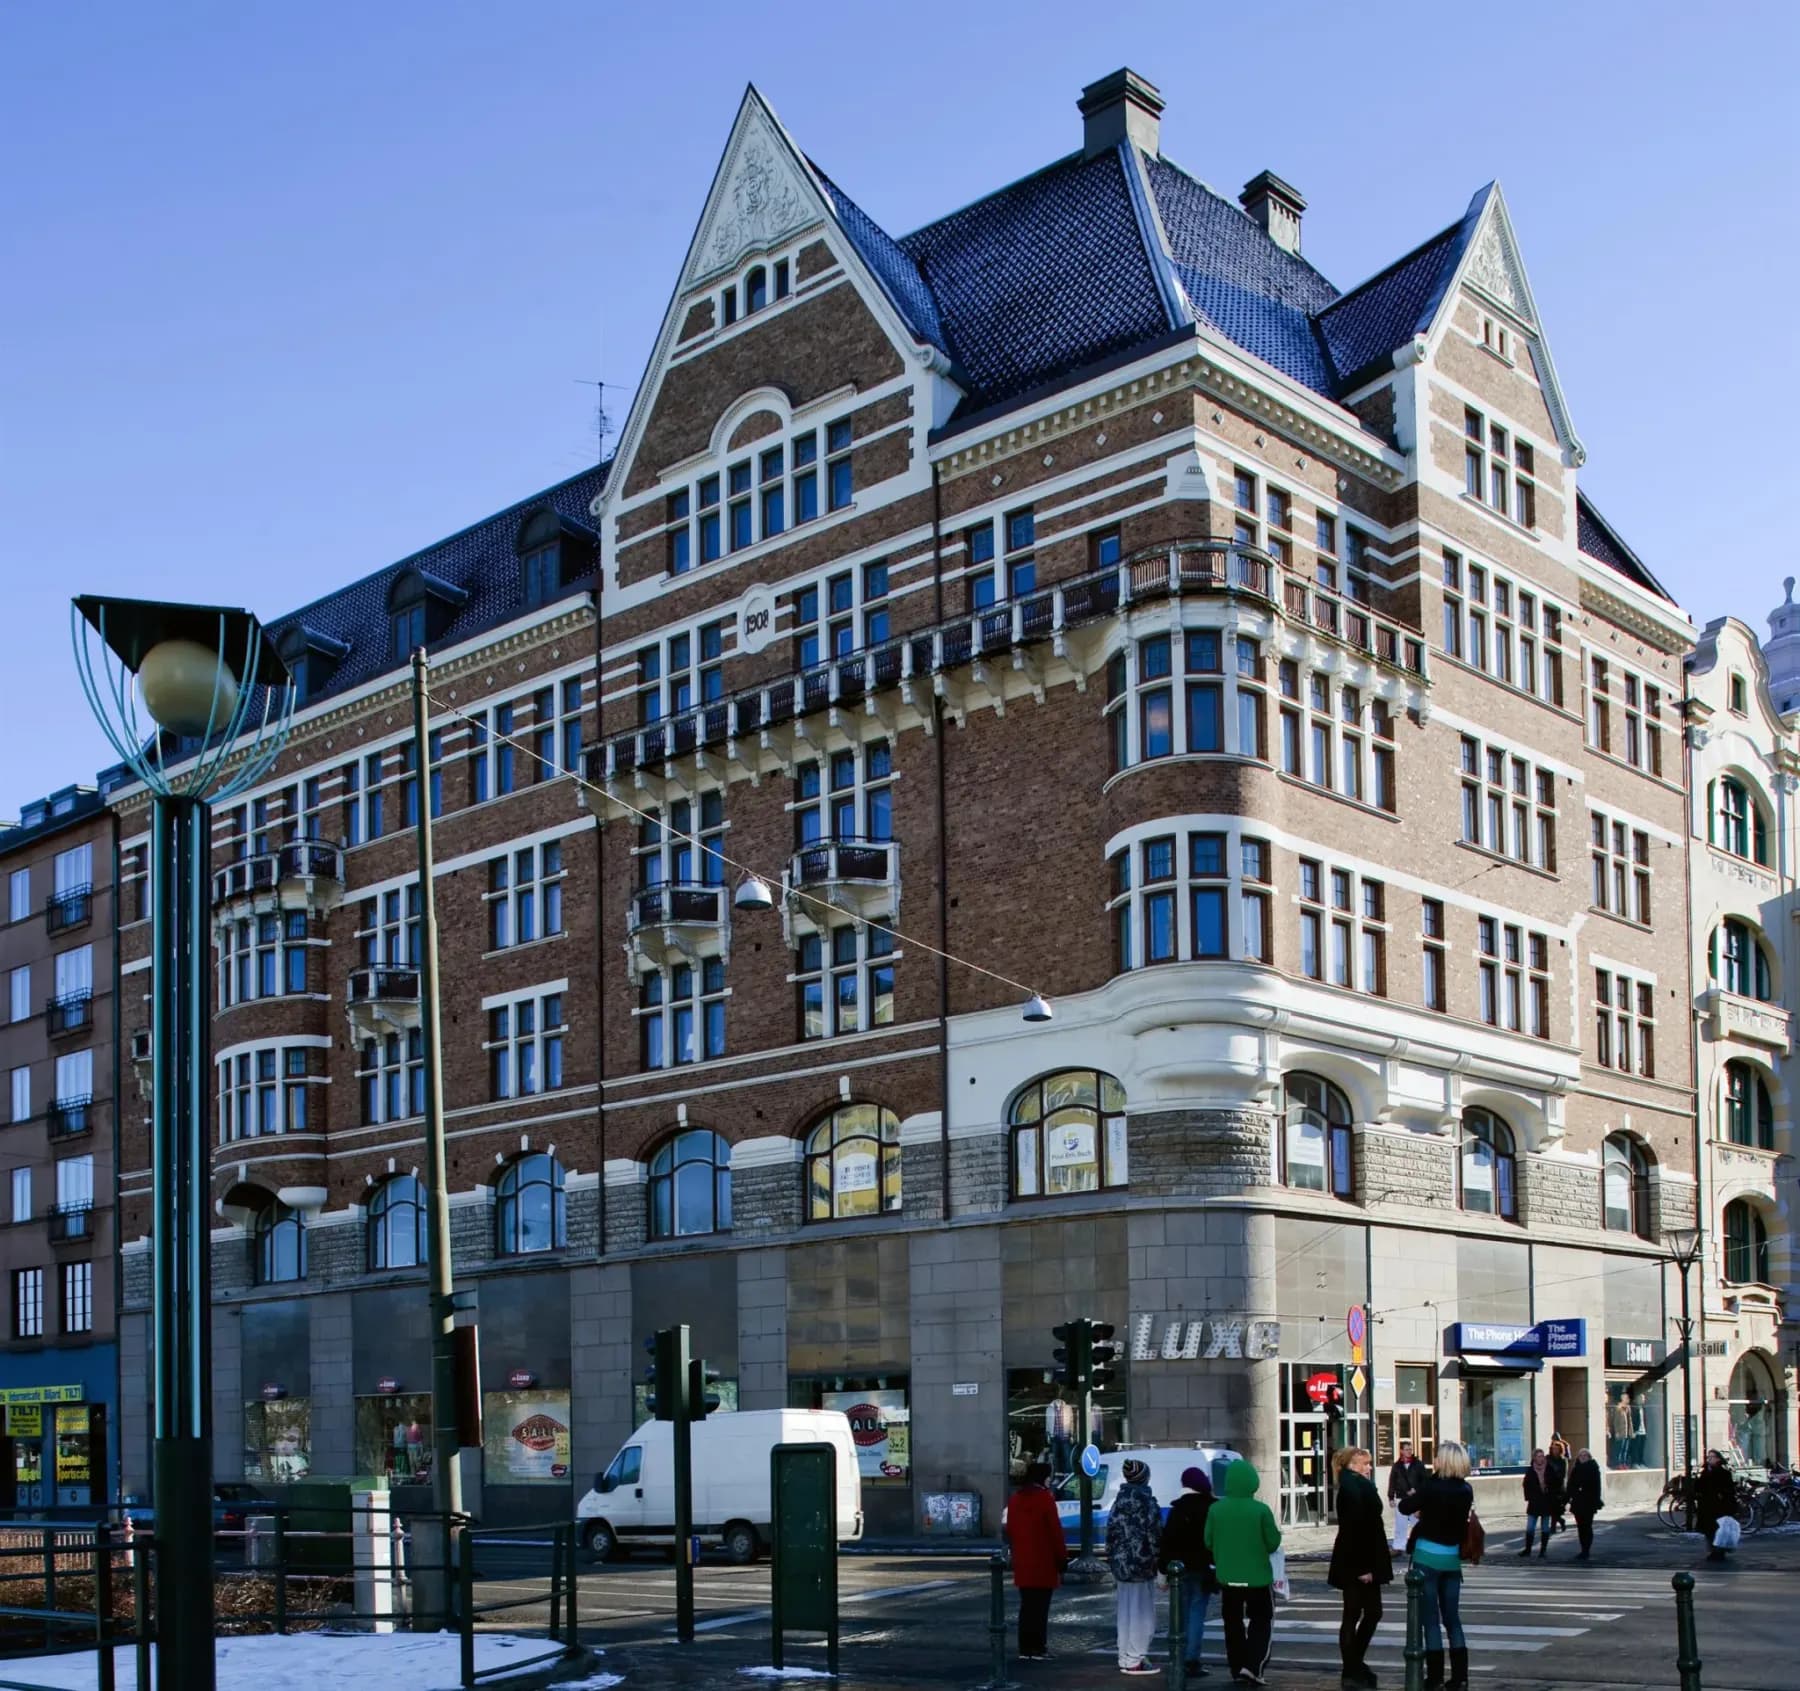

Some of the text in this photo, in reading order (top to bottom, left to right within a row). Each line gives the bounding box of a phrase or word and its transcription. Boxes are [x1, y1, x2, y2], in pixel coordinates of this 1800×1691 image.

[745, 608, 769, 636] 1908
[1547, 1324, 1566, 1332] The
[1130, 1313, 1280, 1361] Luxe
[1468, 1328, 1540, 1343] The Phone House
[1547, 1333, 1577, 1342] Phone
[1547, 1341, 1577, 1351] House
[1409, 1380, 1417, 1392] 2
